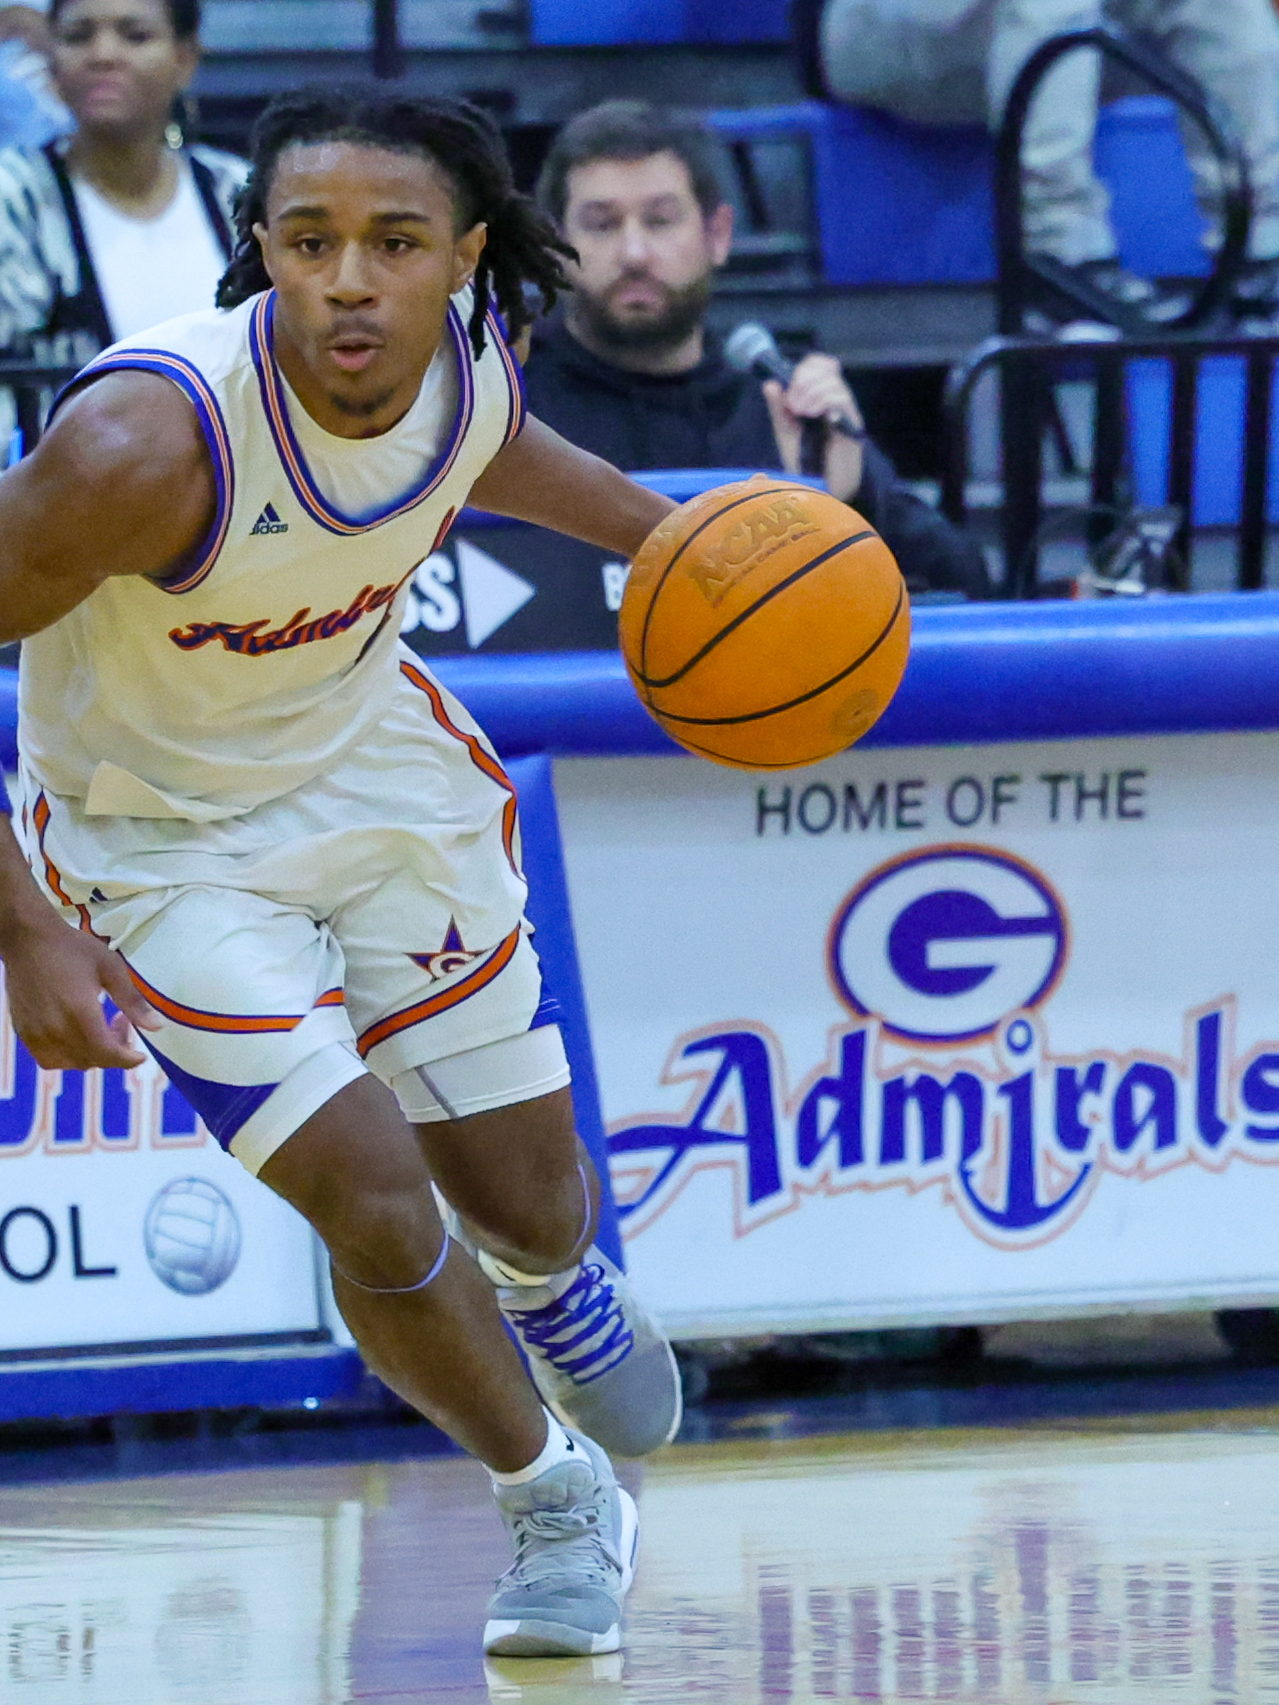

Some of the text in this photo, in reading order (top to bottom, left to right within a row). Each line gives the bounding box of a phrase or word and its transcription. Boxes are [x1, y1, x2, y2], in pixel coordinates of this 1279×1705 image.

[687, 498, 815, 602] NCAA
[754, 769, 1149, 836] HOME OF THE
[825, 840, 1073, 1052] G
[607, 996, 1279, 1244] Admirals
